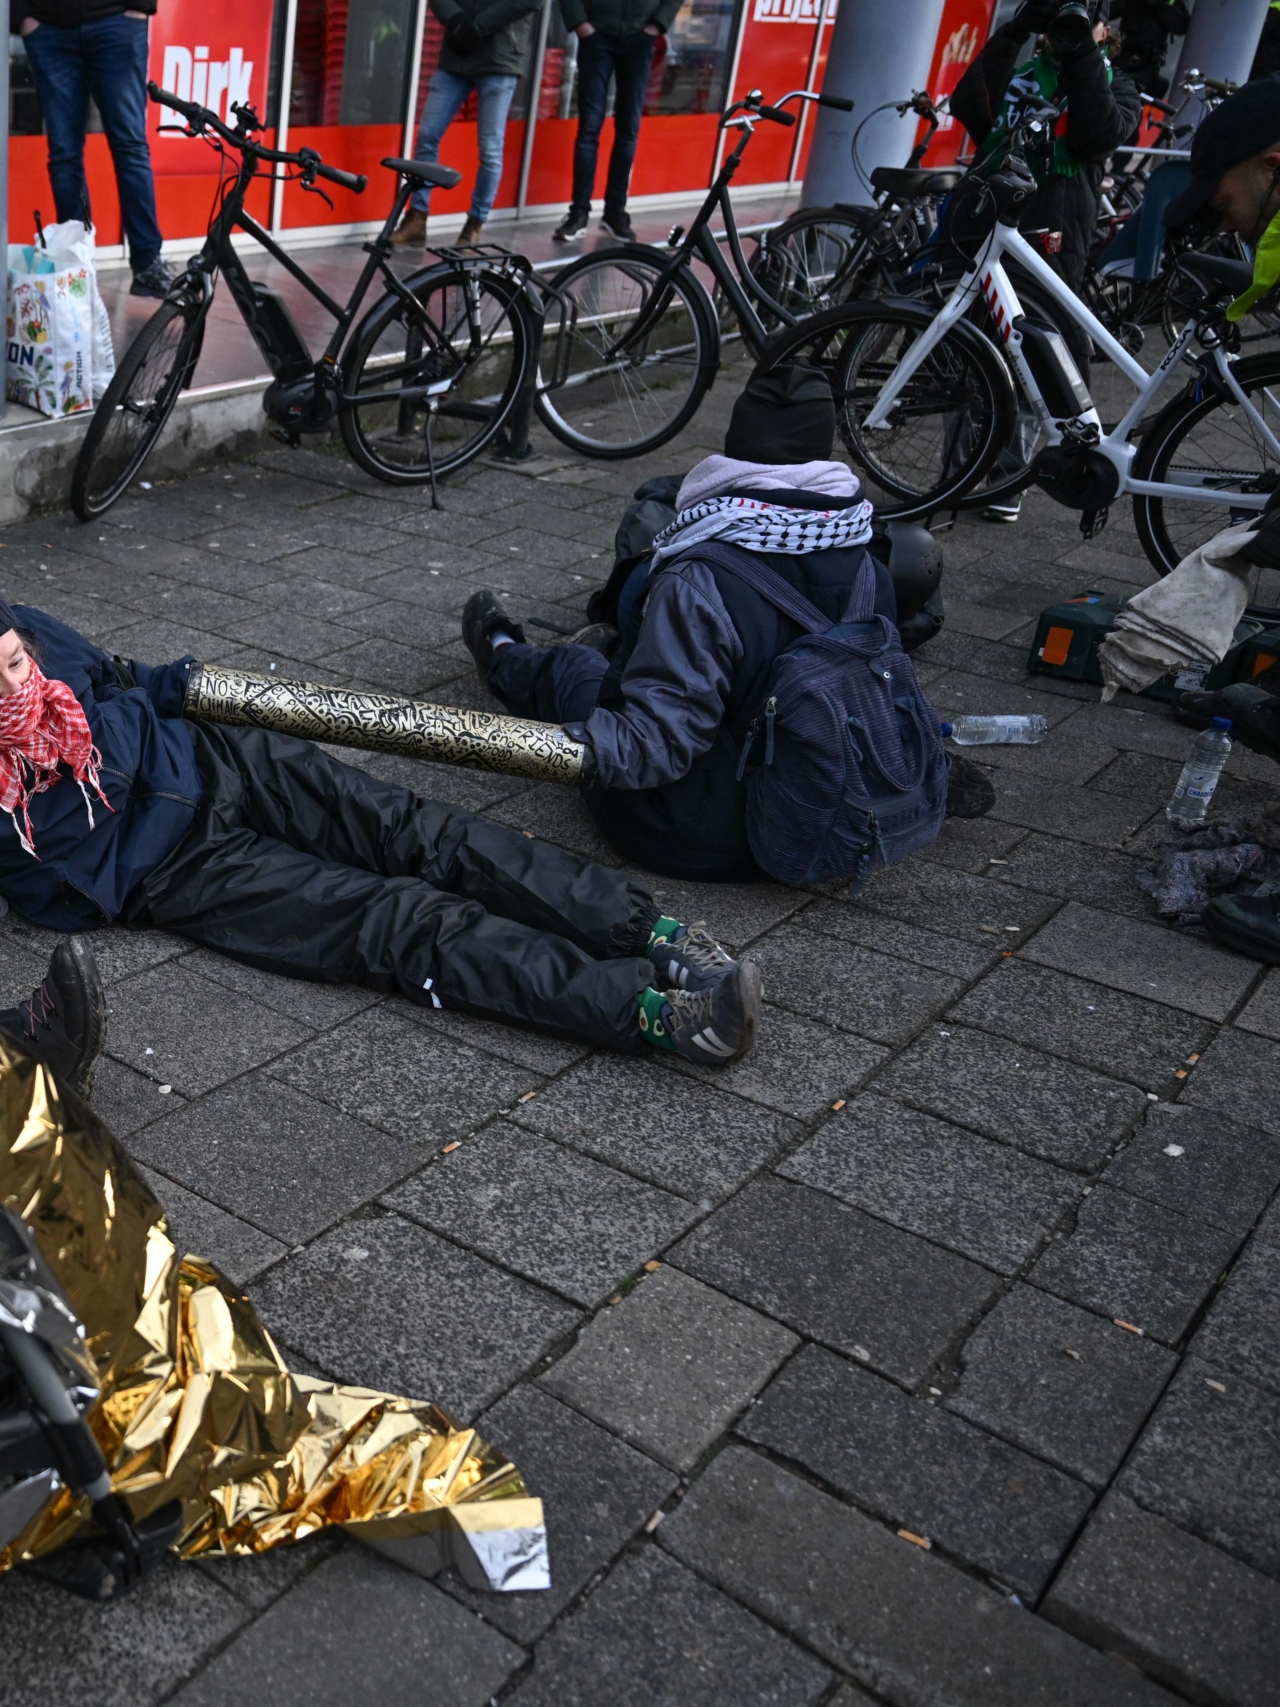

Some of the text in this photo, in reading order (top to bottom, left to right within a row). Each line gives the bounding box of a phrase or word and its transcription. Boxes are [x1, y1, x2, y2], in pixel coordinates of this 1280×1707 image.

[160, 46, 254, 131] Dirk
[1160, 328, 1192, 371] KOGA
[205, 678, 228, 697] NO
